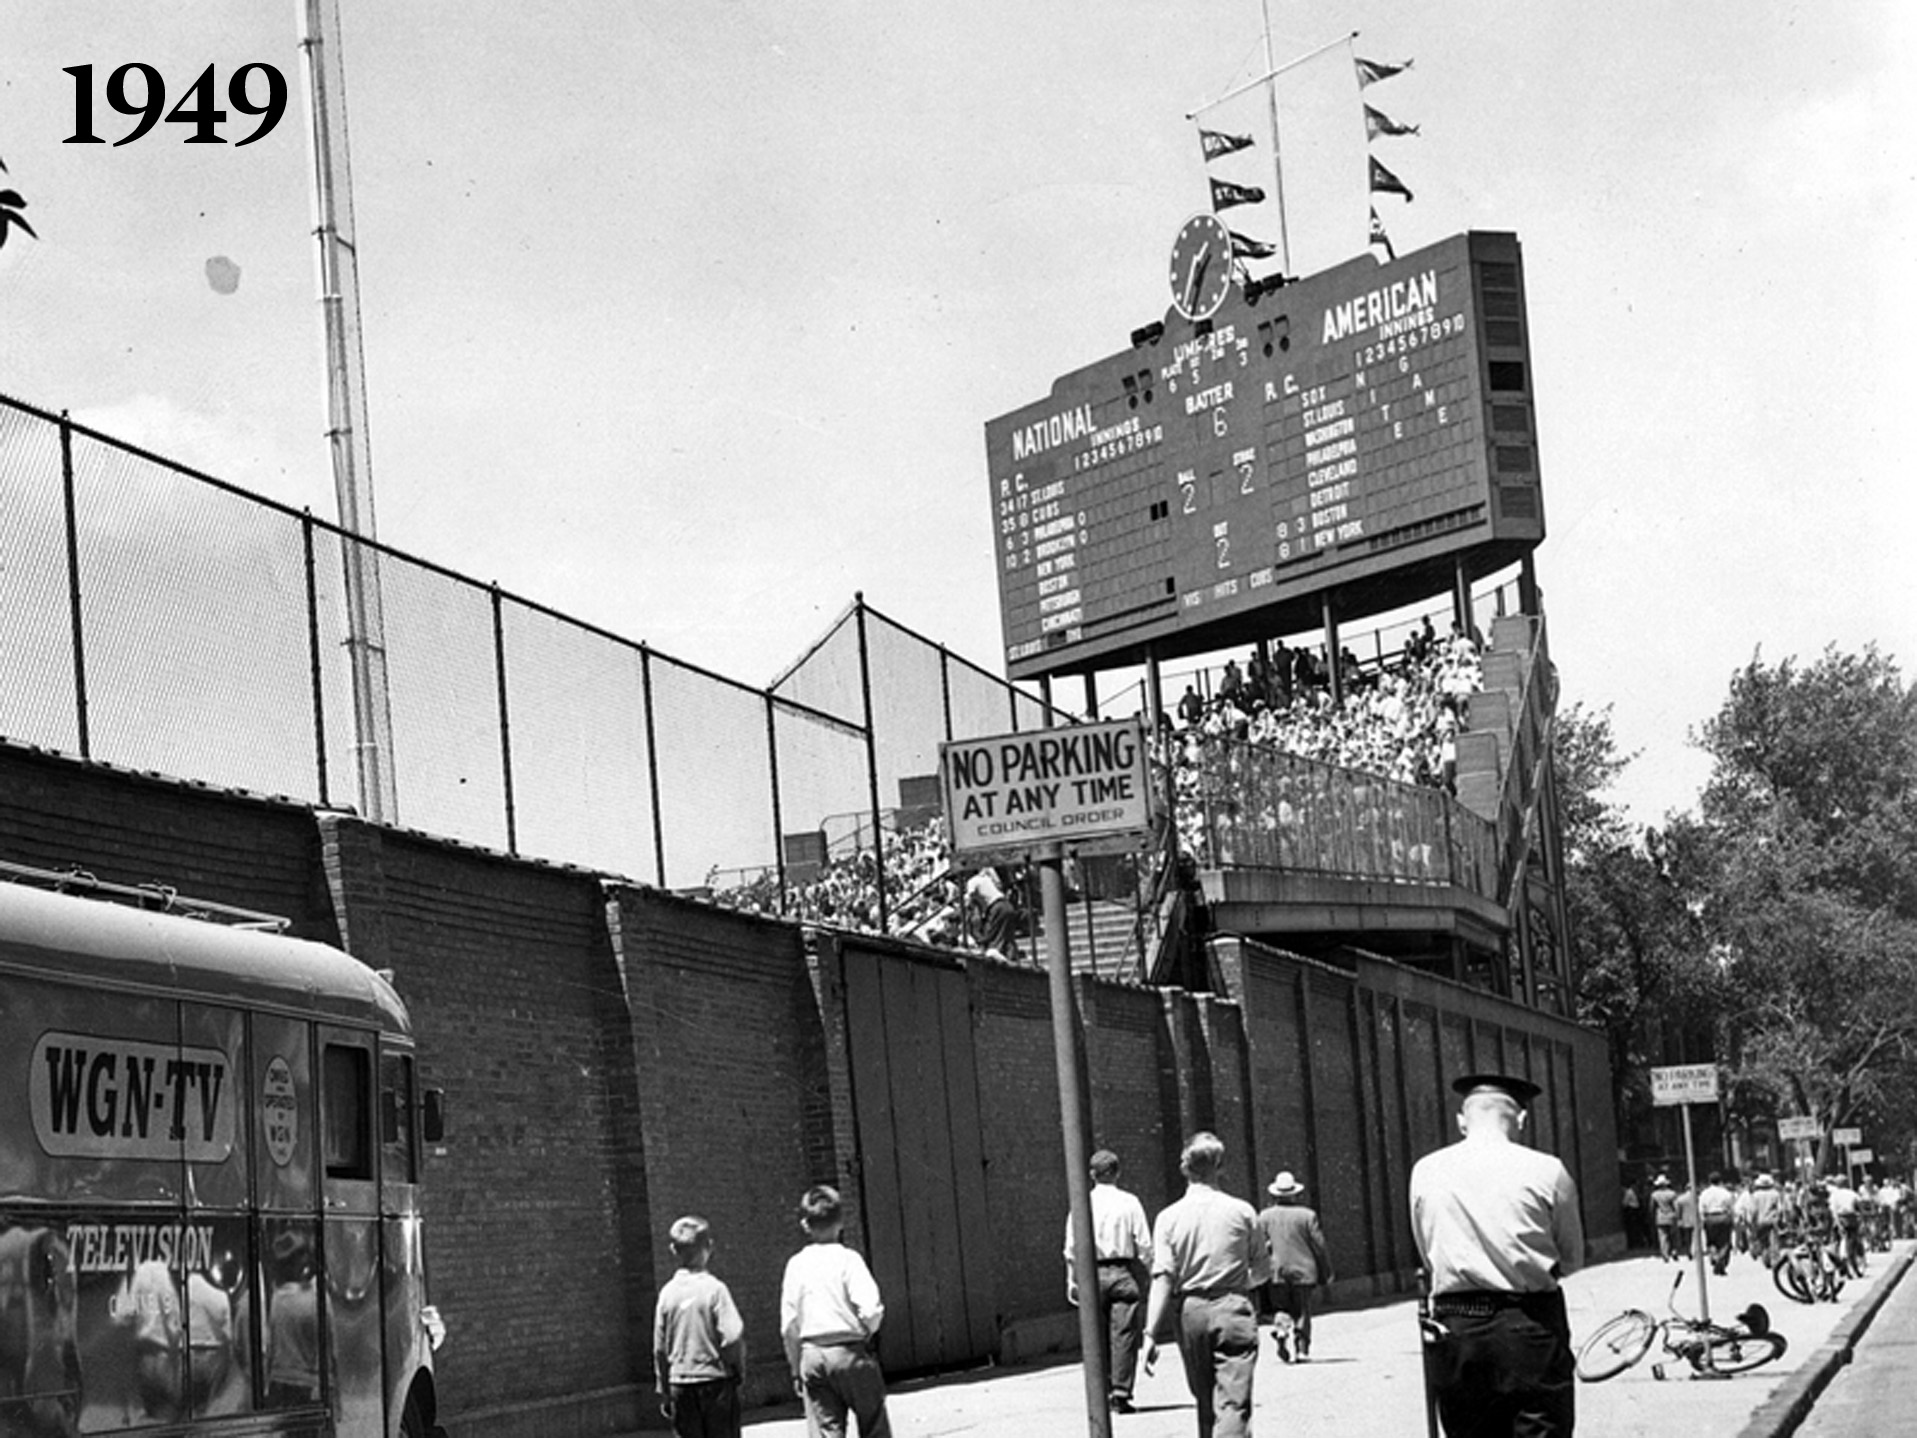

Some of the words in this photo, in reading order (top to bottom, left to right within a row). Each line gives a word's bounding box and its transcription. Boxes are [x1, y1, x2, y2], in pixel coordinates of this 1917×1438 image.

[1323, 270, 1438, 344] AMERICAN
[1185, 382, 1234, 415] BATTER
[1301, 386, 1326, 408] SOX
[1012, 403, 1097, 461] NATIONAL
[1213, 406, 1228, 437] 6
[1182, 484, 1197, 514] 2
[1239, 463, 1255, 495] 2
[1310, 480, 1350, 509] DETROIT
[1032, 501, 1060, 523] CUBS
[1078, 511, 1086, 526] 0
[1216, 538, 1231, 569] 2
[1213, 580, 1238, 600] HITS
[953, 748, 993, 789] NO
[1001, 730, 1134, 783] PARKING
[963, 791, 998, 820] AT
[1006, 783, 1060, 815] ANY
[1071, 774, 1134, 805] TIME
[977, 817, 1056, 836] COUNCIL
[1061, 807, 1124, 826] ORDER
[45, 1046, 223, 1142] WGN-TV
[66, 1226, 213, 1272] TELEVISION
